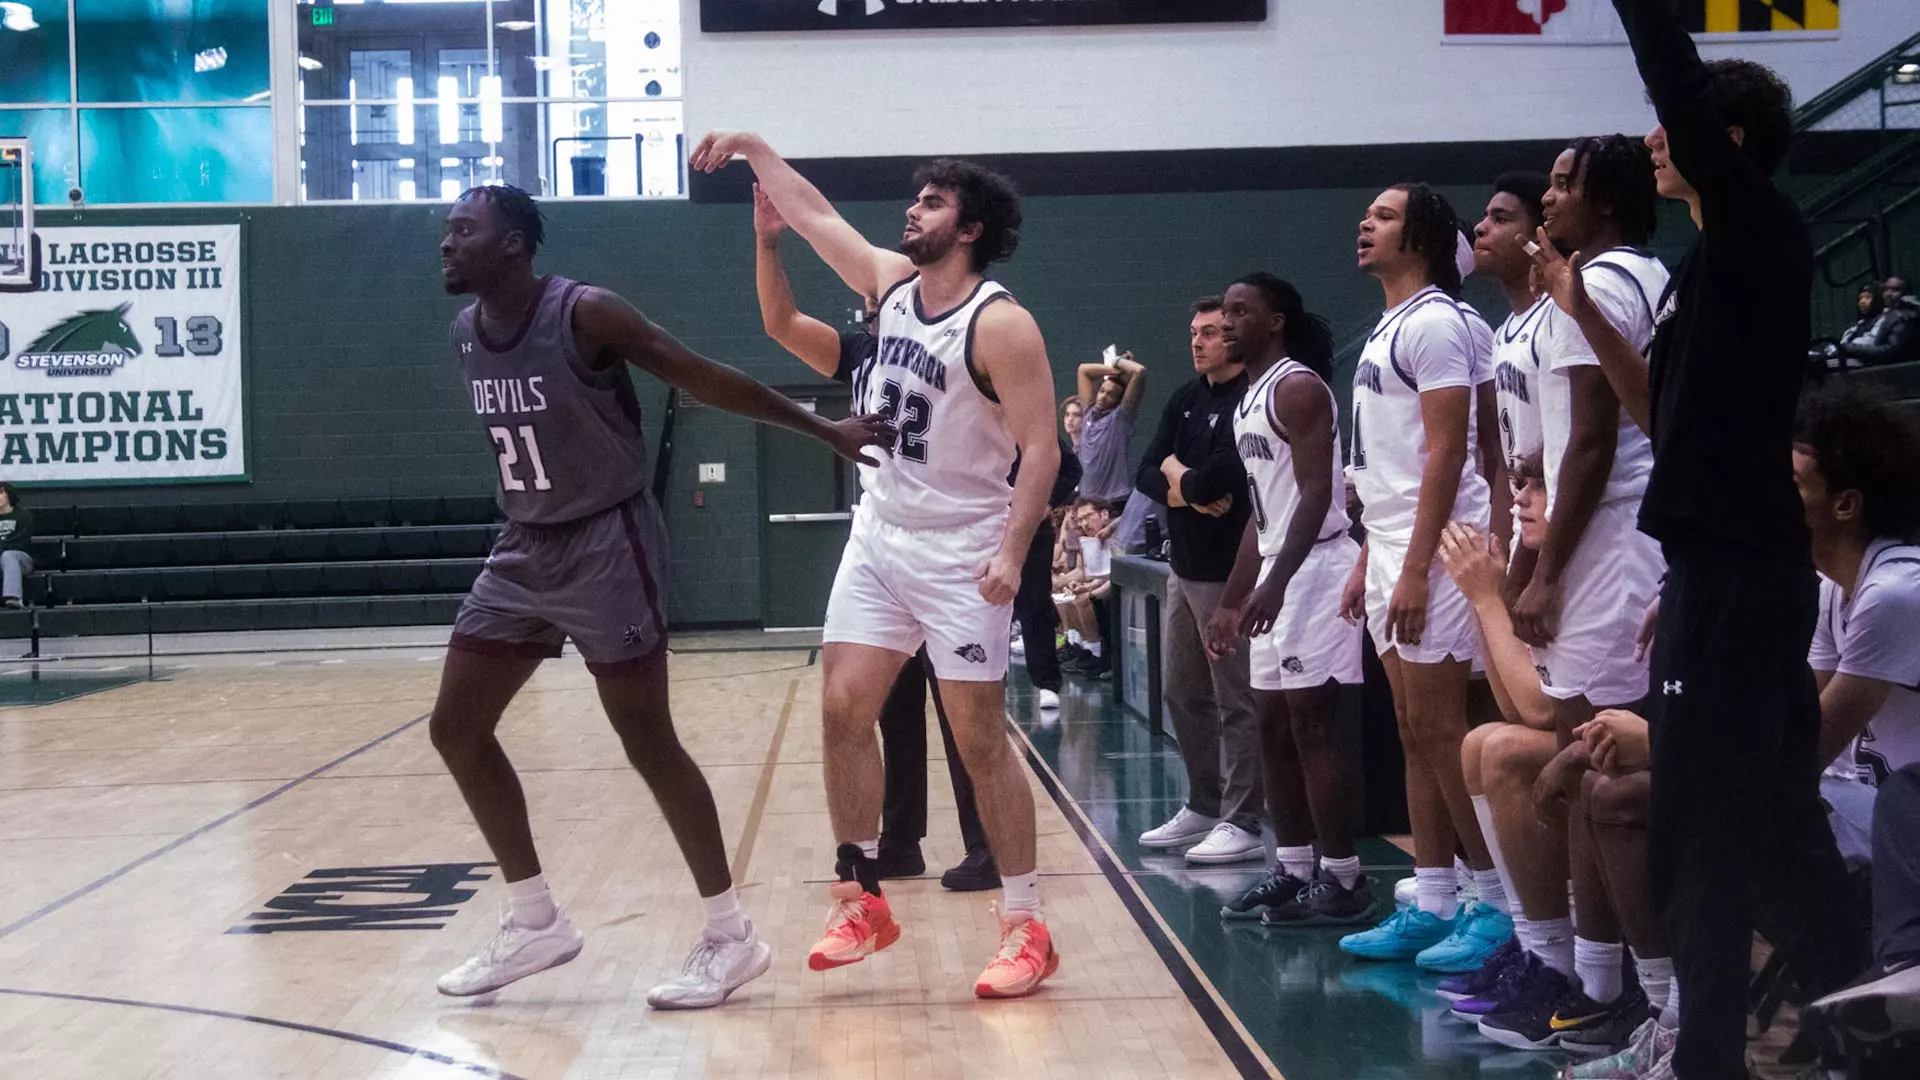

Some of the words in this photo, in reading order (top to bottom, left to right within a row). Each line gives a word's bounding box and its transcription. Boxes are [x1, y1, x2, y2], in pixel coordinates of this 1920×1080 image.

[313, 7, 333, 25] EXIT
[49, 241, 216, 264] LACROSSE
[186, 267, 222, 289] III
[155, 315, 222, 357] 13
[17, 353, 123, 368] STEVENSON
[47, 366, 113, 377] UNIVERSITY
[0, 390, 203, 425] ATIONAL
[472, 376, 547, 415] DEVILS
[1, 428, 227, 464] AMPIONS
[489, 425, 552, 491] 21
